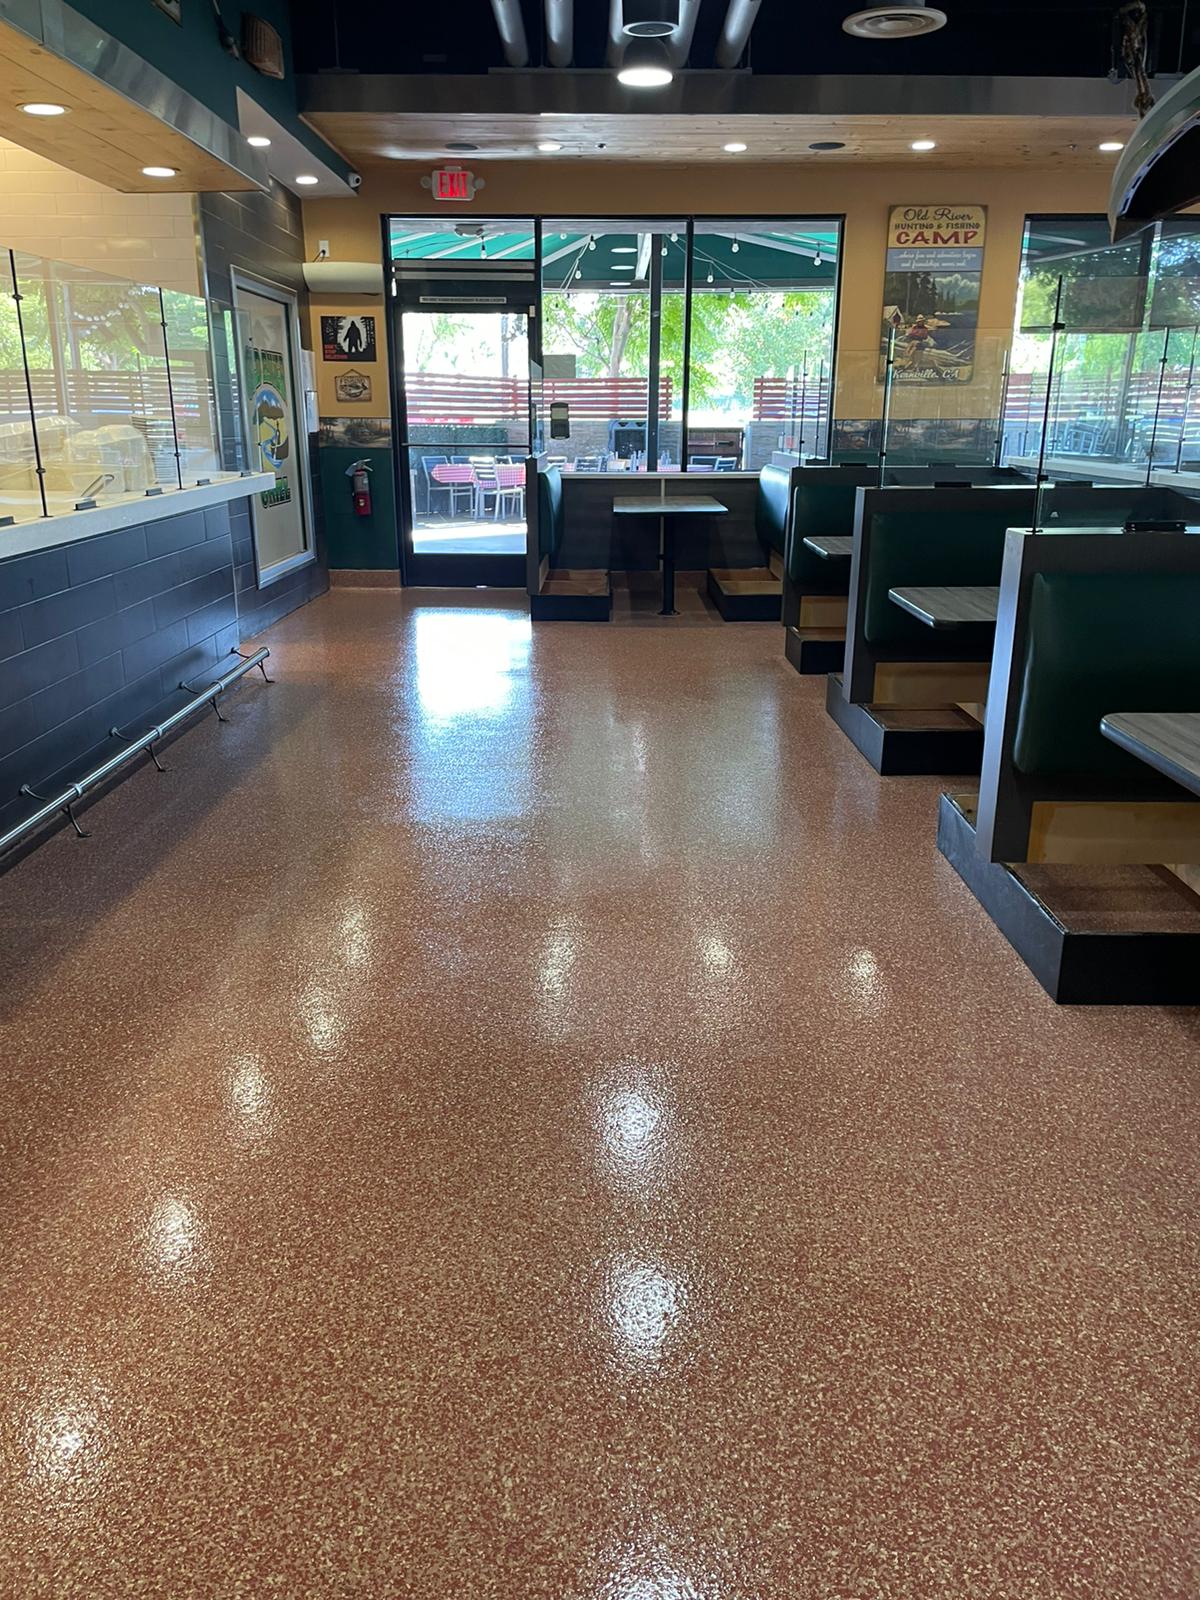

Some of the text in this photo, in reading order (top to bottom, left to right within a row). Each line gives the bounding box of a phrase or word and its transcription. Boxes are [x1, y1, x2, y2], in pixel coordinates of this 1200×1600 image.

[438, 172, 468, 198] EXIT
[903, 208, 973, 221] Old River
[894, 222, 980, 230] HUNTING & FISHING
[896, 231, 978, 244] CAMP
